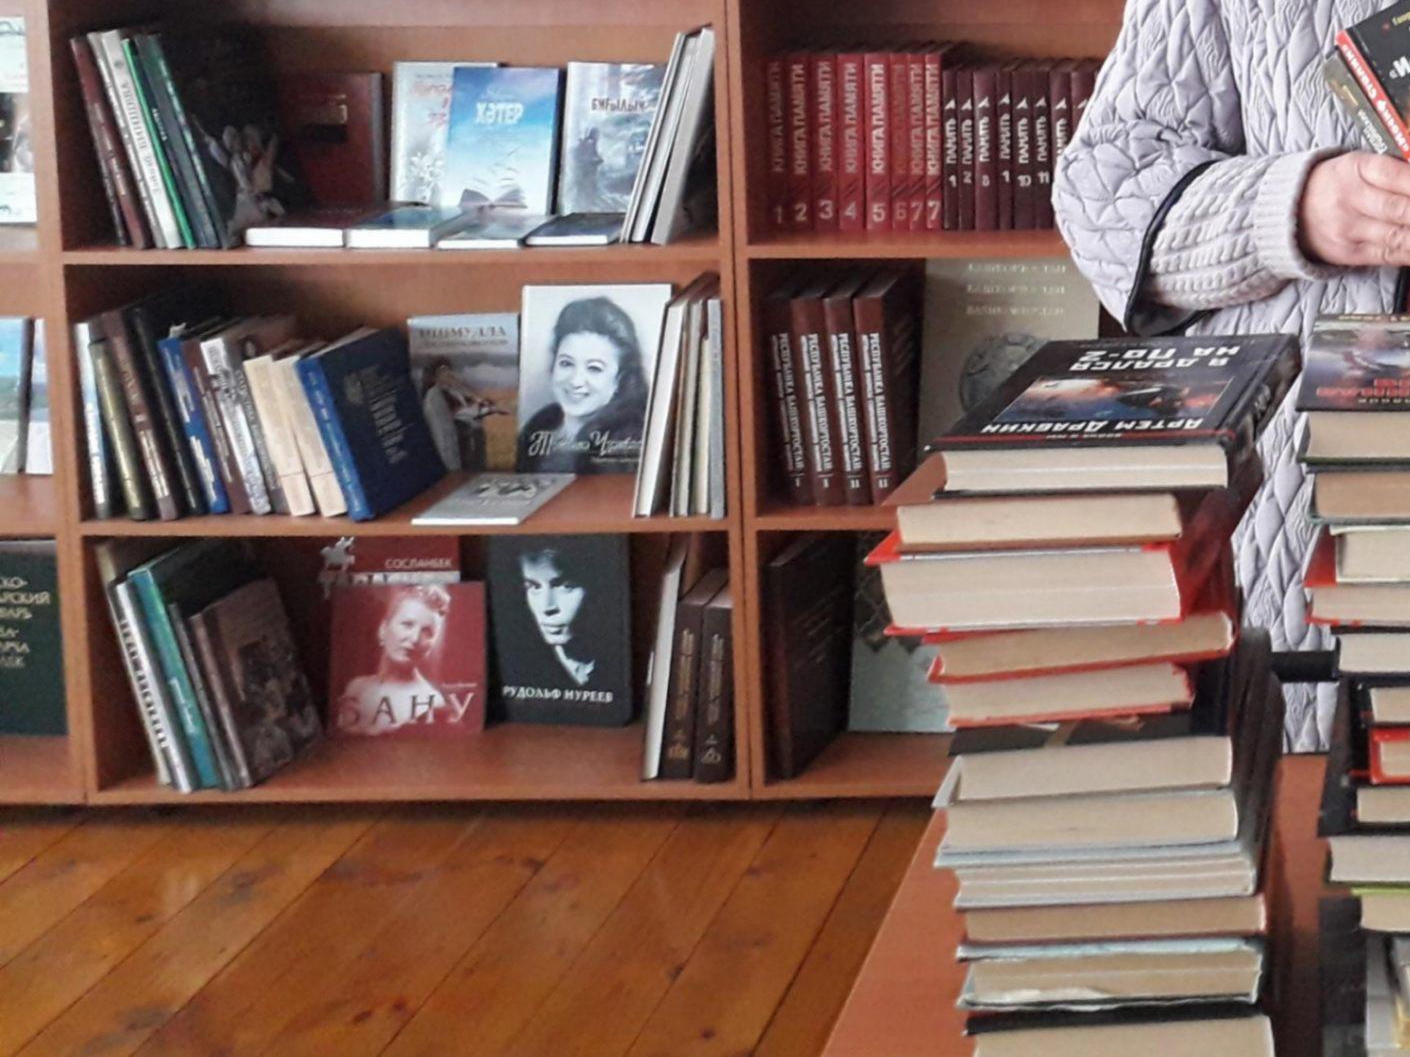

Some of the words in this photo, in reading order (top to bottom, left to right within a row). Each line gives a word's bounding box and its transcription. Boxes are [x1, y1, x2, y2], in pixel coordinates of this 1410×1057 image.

[473, 101, 525, 126] ХӘТЕР
[794, 202, 807, 222] 2
[819, 199, 833, 220] 3
[843, 201, 857, 220] 4
[871, 202, 886, 223] 5
[910, 201, 923, 221] 7
[927, 200, 941, 221] 7
[1193, 345, 1241, 357] НА
[1069, 357, 1199, 372] ДРАЛСЯ
[1208, 357, 1228, 367] Я
[502, 685, 563, 702] РУДОЛЬФ
[567, 687, 613, 704] НУРЕЕВ
